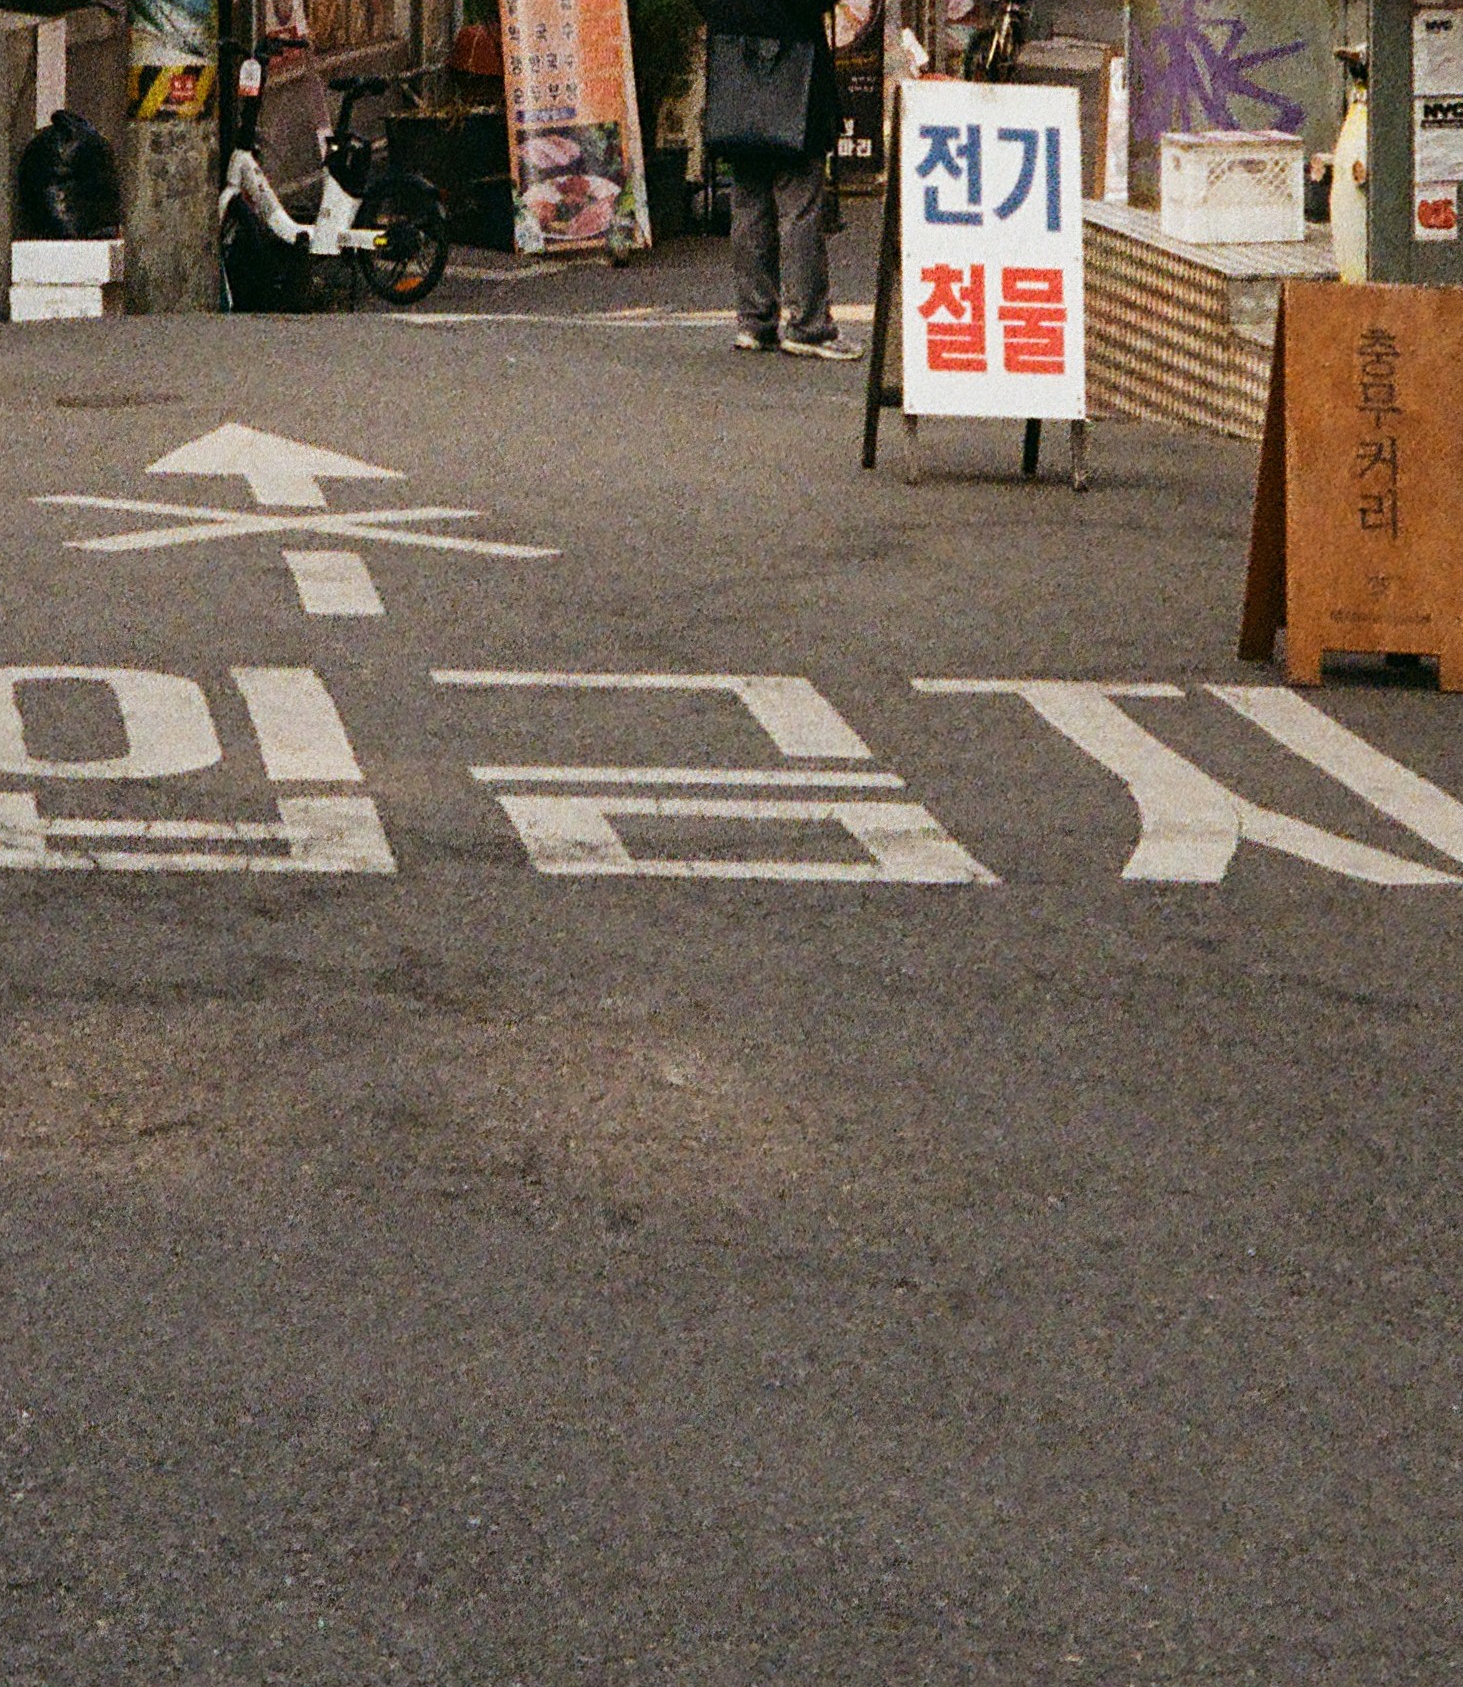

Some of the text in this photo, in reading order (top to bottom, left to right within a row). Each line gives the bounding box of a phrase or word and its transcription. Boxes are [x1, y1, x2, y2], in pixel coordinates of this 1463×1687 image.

[915, 122, 1064, 234] 전기
[917, 261, 1070, 375] 철물
[1356, 327, 1404, 541] 충무커리
